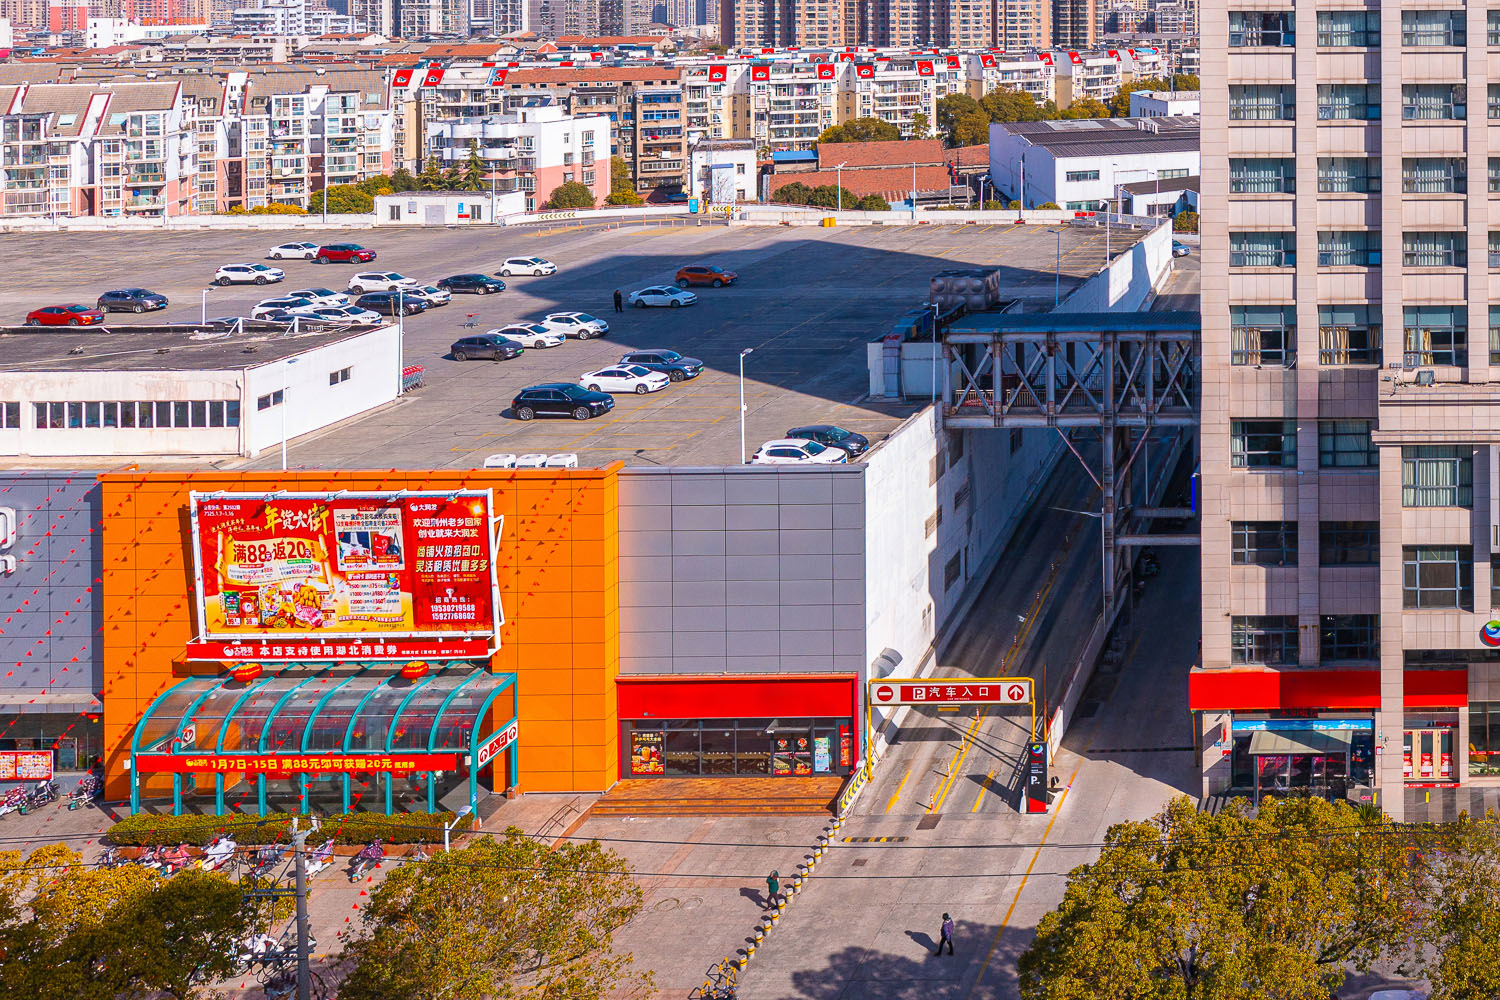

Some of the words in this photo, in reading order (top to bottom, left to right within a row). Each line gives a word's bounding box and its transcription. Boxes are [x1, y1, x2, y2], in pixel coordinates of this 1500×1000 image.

[264, 503, 330, 536] 年货大街
[413, 517, 482, 528] 欢迎荆州老乡回家
[418, 529, 479, 538] 创业就来大润发
[233, 541, 312, 563] 满88元返20元
[259, 645, 397, 657] 本店支持使用湖北消费券
[929, 686, 989, 698] 汽车入口
[492, 734, 506, 752] 入口
[210, 758, 278, 770] 1月7日-15日
[282, 758, 392, 770] 满88元即可获赠20元
